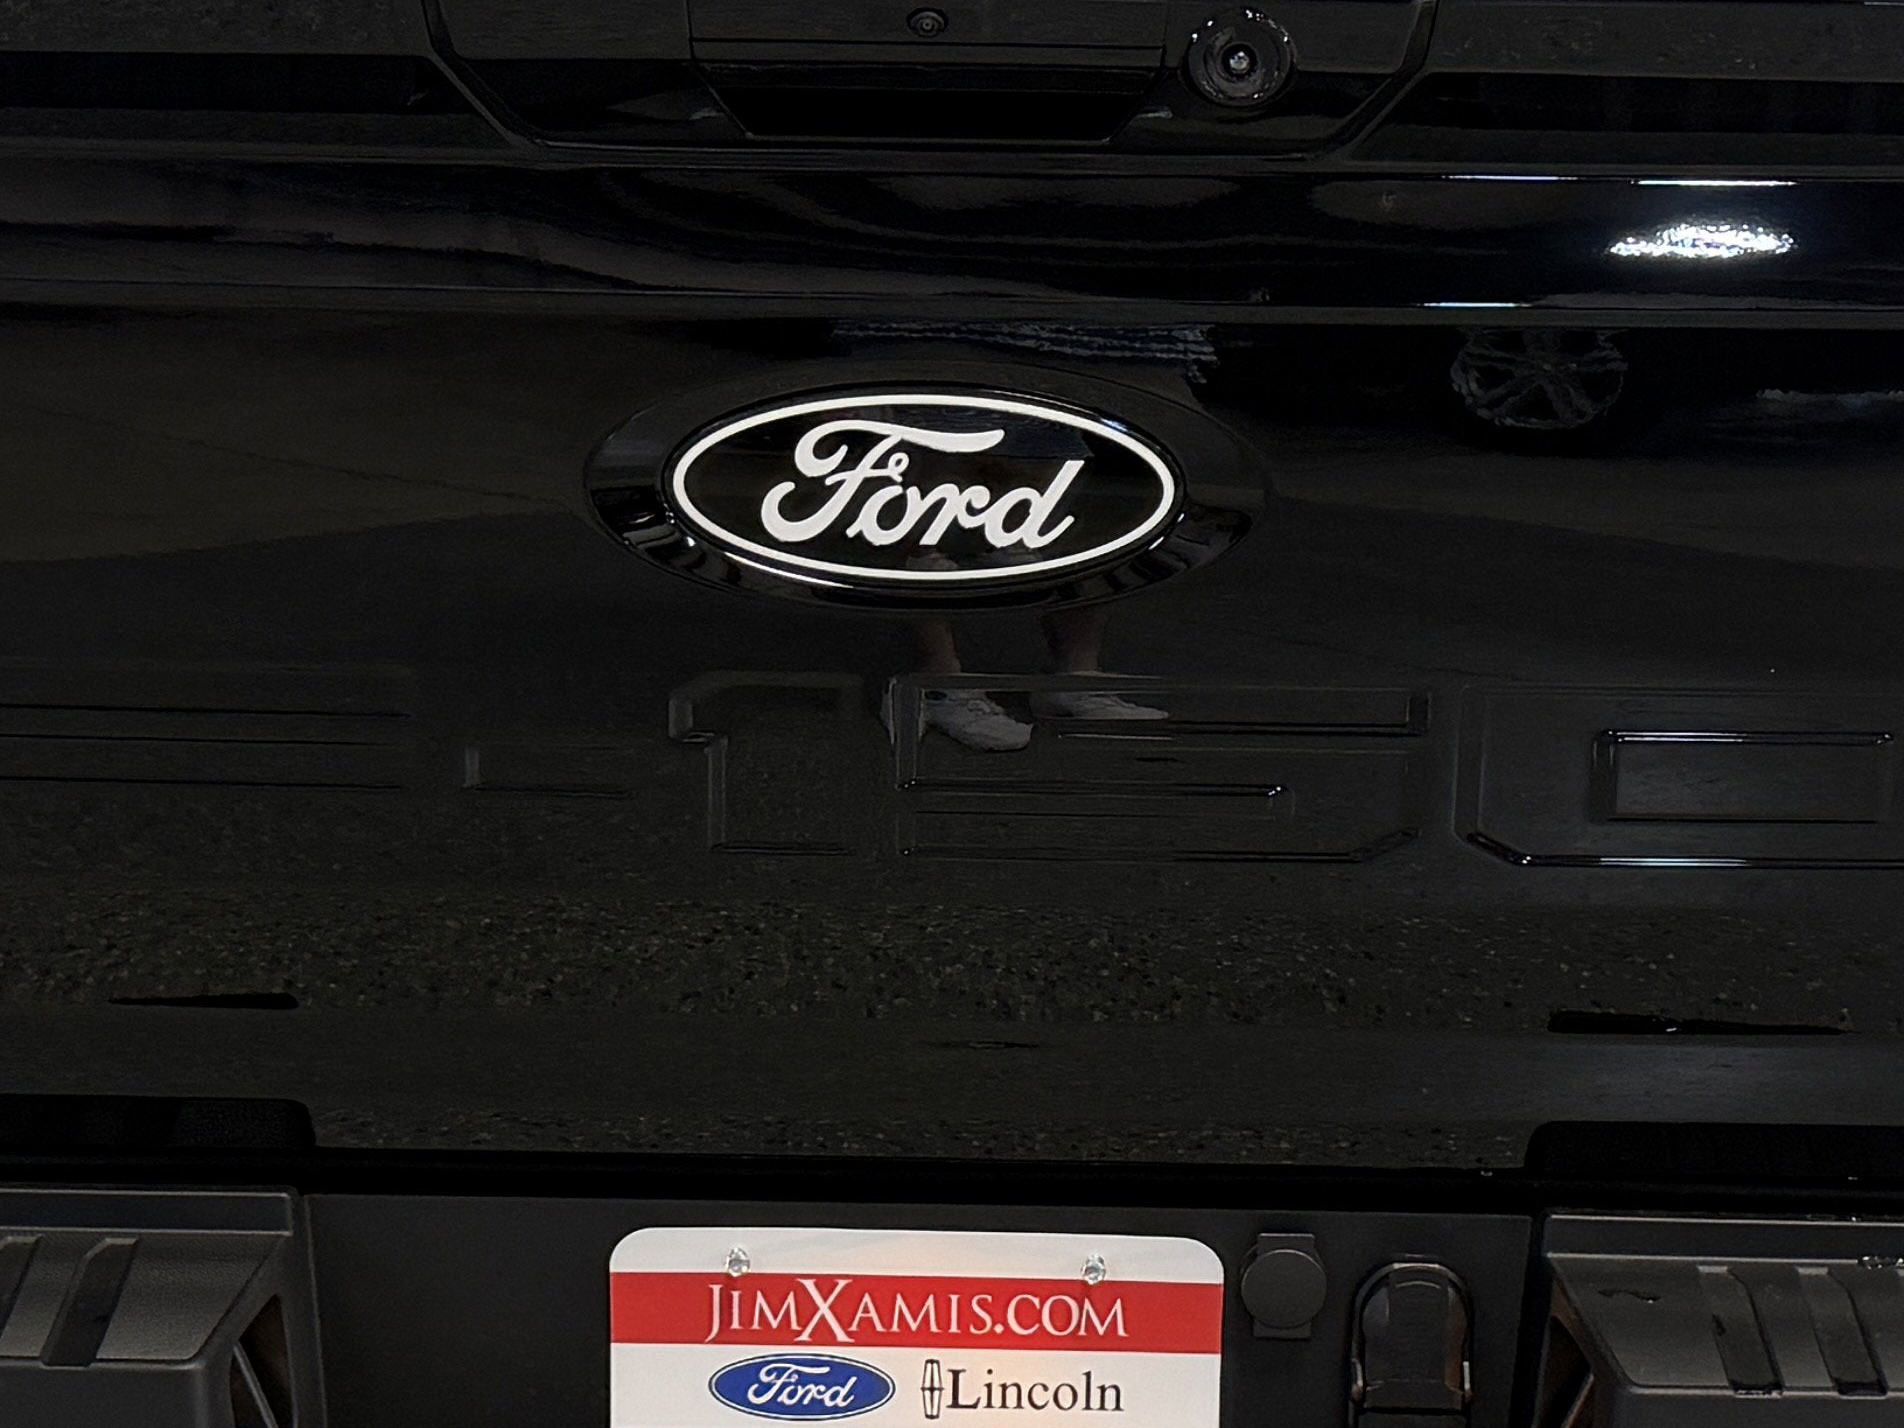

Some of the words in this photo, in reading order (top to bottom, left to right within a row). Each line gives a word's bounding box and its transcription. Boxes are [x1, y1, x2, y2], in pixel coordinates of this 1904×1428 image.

[760, 418, 1085, 549] Ford
[746, 1362, 859, 1409] Ford
[946, 1368, 1125, 1414] Lincoln
